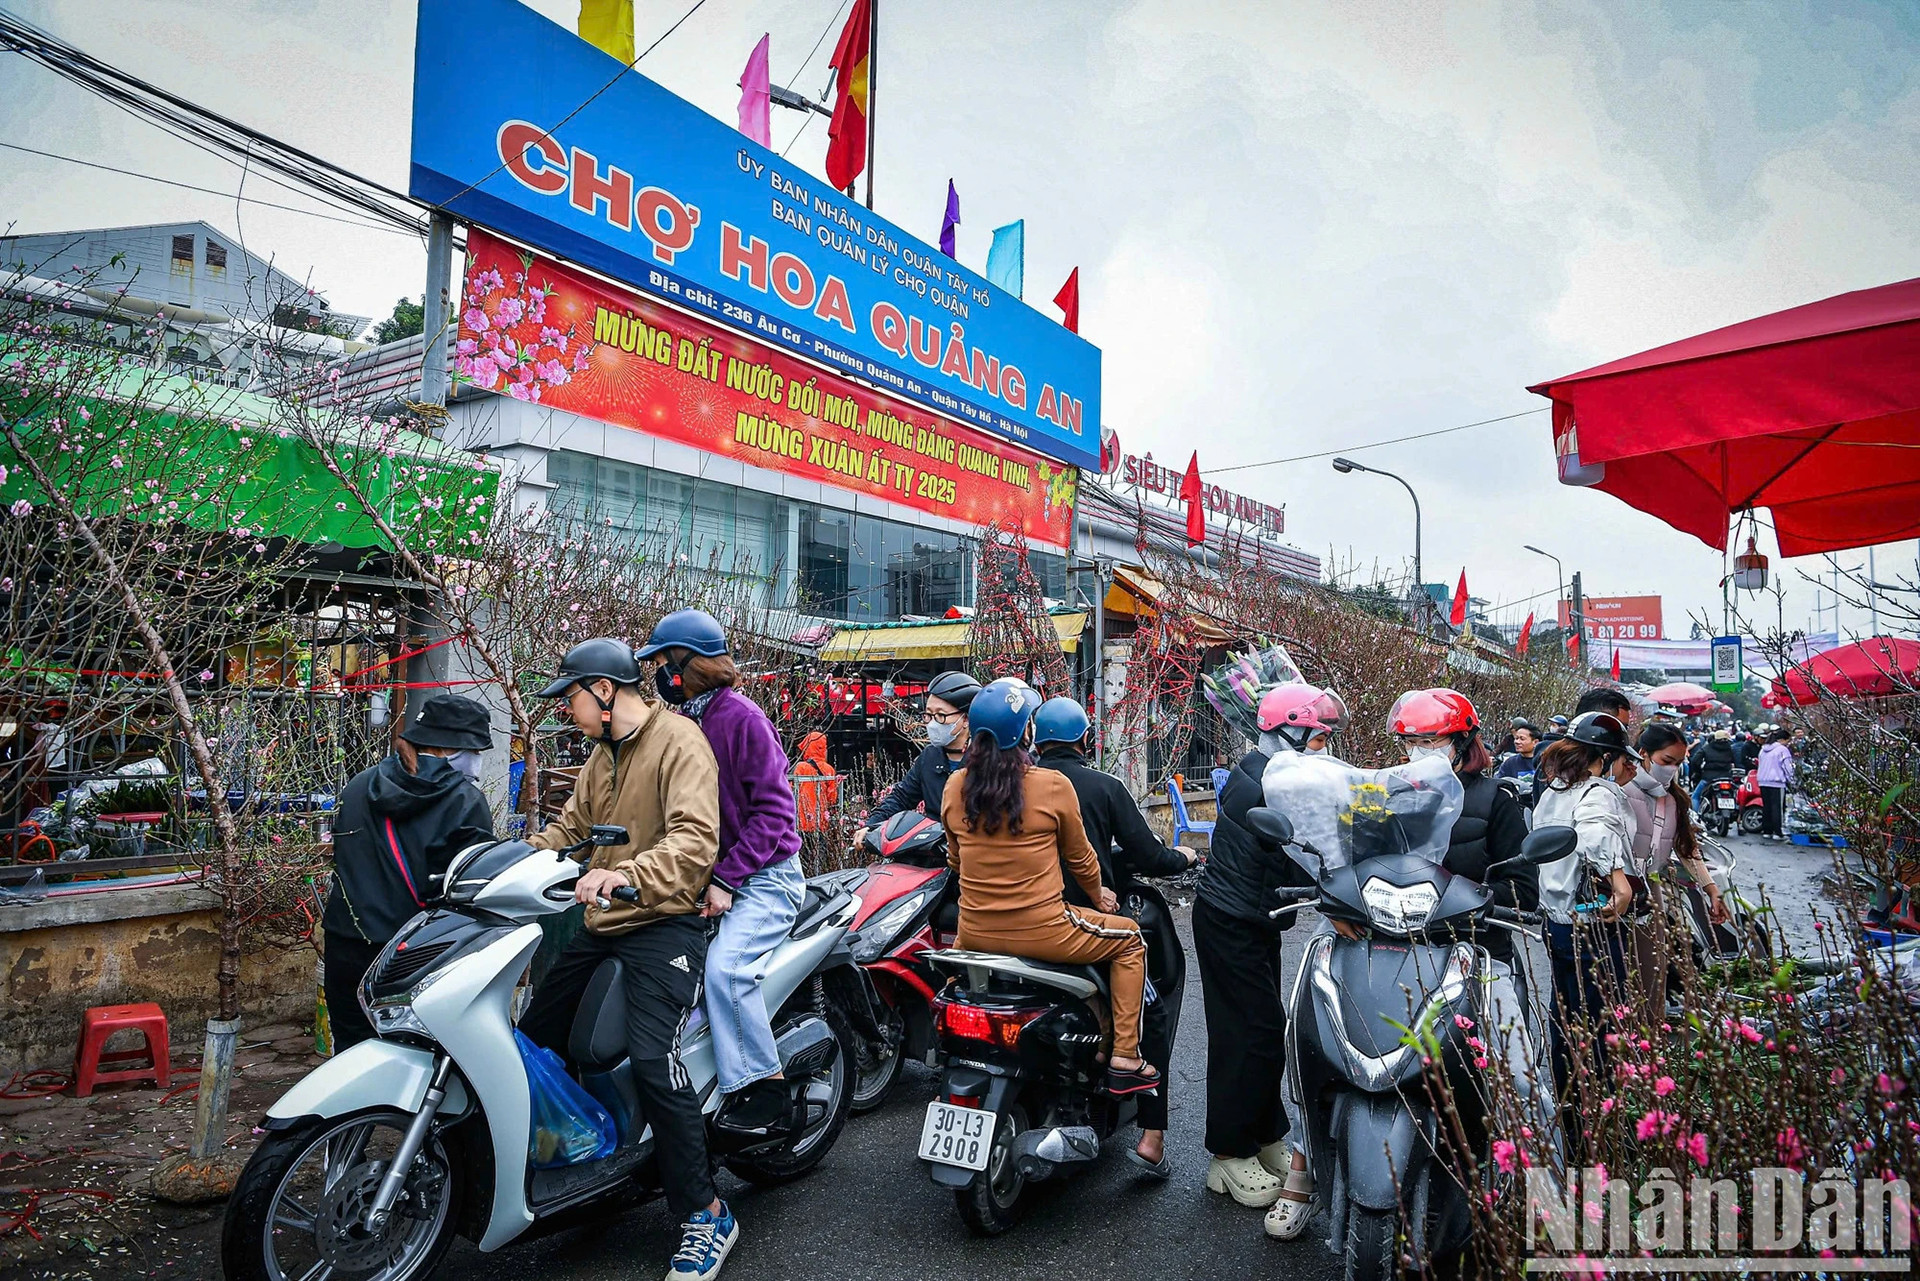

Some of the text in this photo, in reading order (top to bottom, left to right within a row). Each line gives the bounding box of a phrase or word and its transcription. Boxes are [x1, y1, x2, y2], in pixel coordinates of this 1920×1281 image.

[496, 119, 1083, 436] CHỢ HOA QUẢNG AN
[737, 149, 991, 308] ỦY BAN NHÂN DÂN QUẬN TÂY HỒ
[771, 199, 969, 320] BAN QUẢN LÝ CHỢ QUẬN
[593, 306, 1031, 493] MỪNG ĐẤT NƯỚC ĐỔI MỚI, MỪNG ĐẢNG QUANG VINH,
[649, 270, 681, 293] Địa
[685, 288, 718, 310] chỉ:
[722, 302, 753, 325] 236
[757, 314, 778, 335] Âu
[781, 326, 802, 344] Cơ
[814, 340, 864, 373] Phường
[866, 363, 904, 389] Quảng
[906, 379, 922, 395] An
[931, 390, 958, 410] Quận
[960, 401, 977, 418] Tây
[979, 410, 992, 424] Hồ
[999, 418, 1011, 432] Hà
[1013, 425, 1029, 440] Nội
[734, 411, 957, 505] MỪNG XUÂN ẤT TỴ 2025
[1126, 451, 1167, 494] SIÊU
[1234, 494, 1263, 526] ANH
[1619, 625, 1635, 638] 20
[1639, 624, 1657, 638] 99
[928, 1133, 979, 1164] 2908
[934, 1108, 984, 1138] 30-L3
